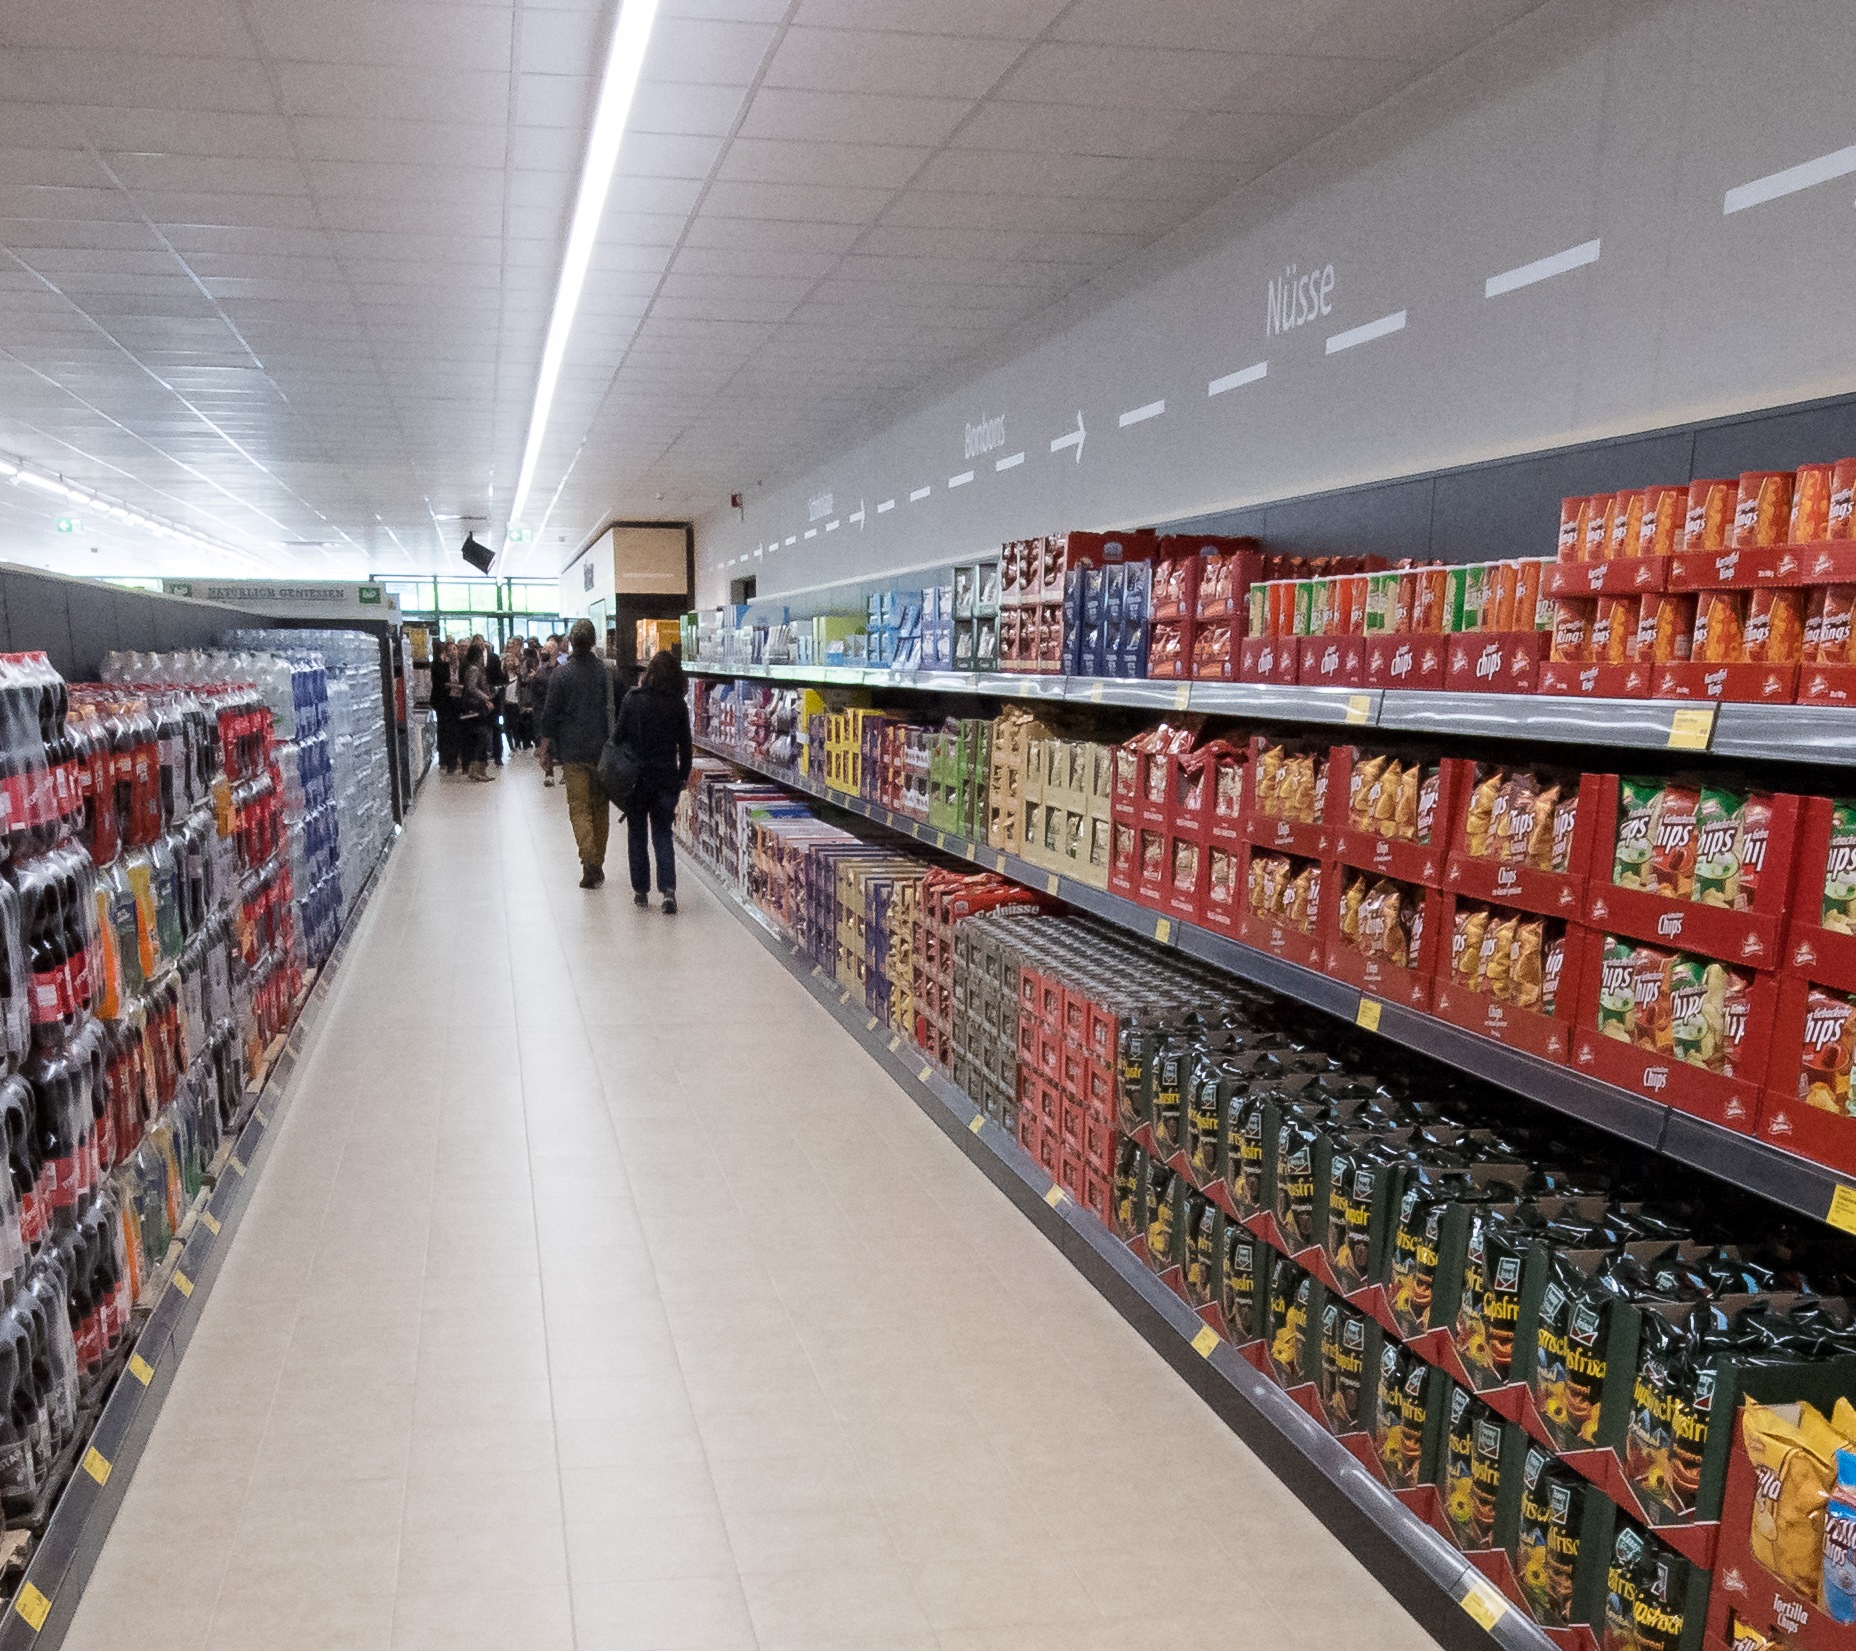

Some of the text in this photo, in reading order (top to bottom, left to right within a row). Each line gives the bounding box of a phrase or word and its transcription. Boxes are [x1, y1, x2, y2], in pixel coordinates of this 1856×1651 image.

[1266, 262, 1335, 337] Nüsse
[1658, 916, 1683, 939] Chips
[1643, 1068, 1667, 1091] Chips
[1772, 1592, 1808, 1626] Tortilla
[1776, 1613, 1799, 1635] Chips
